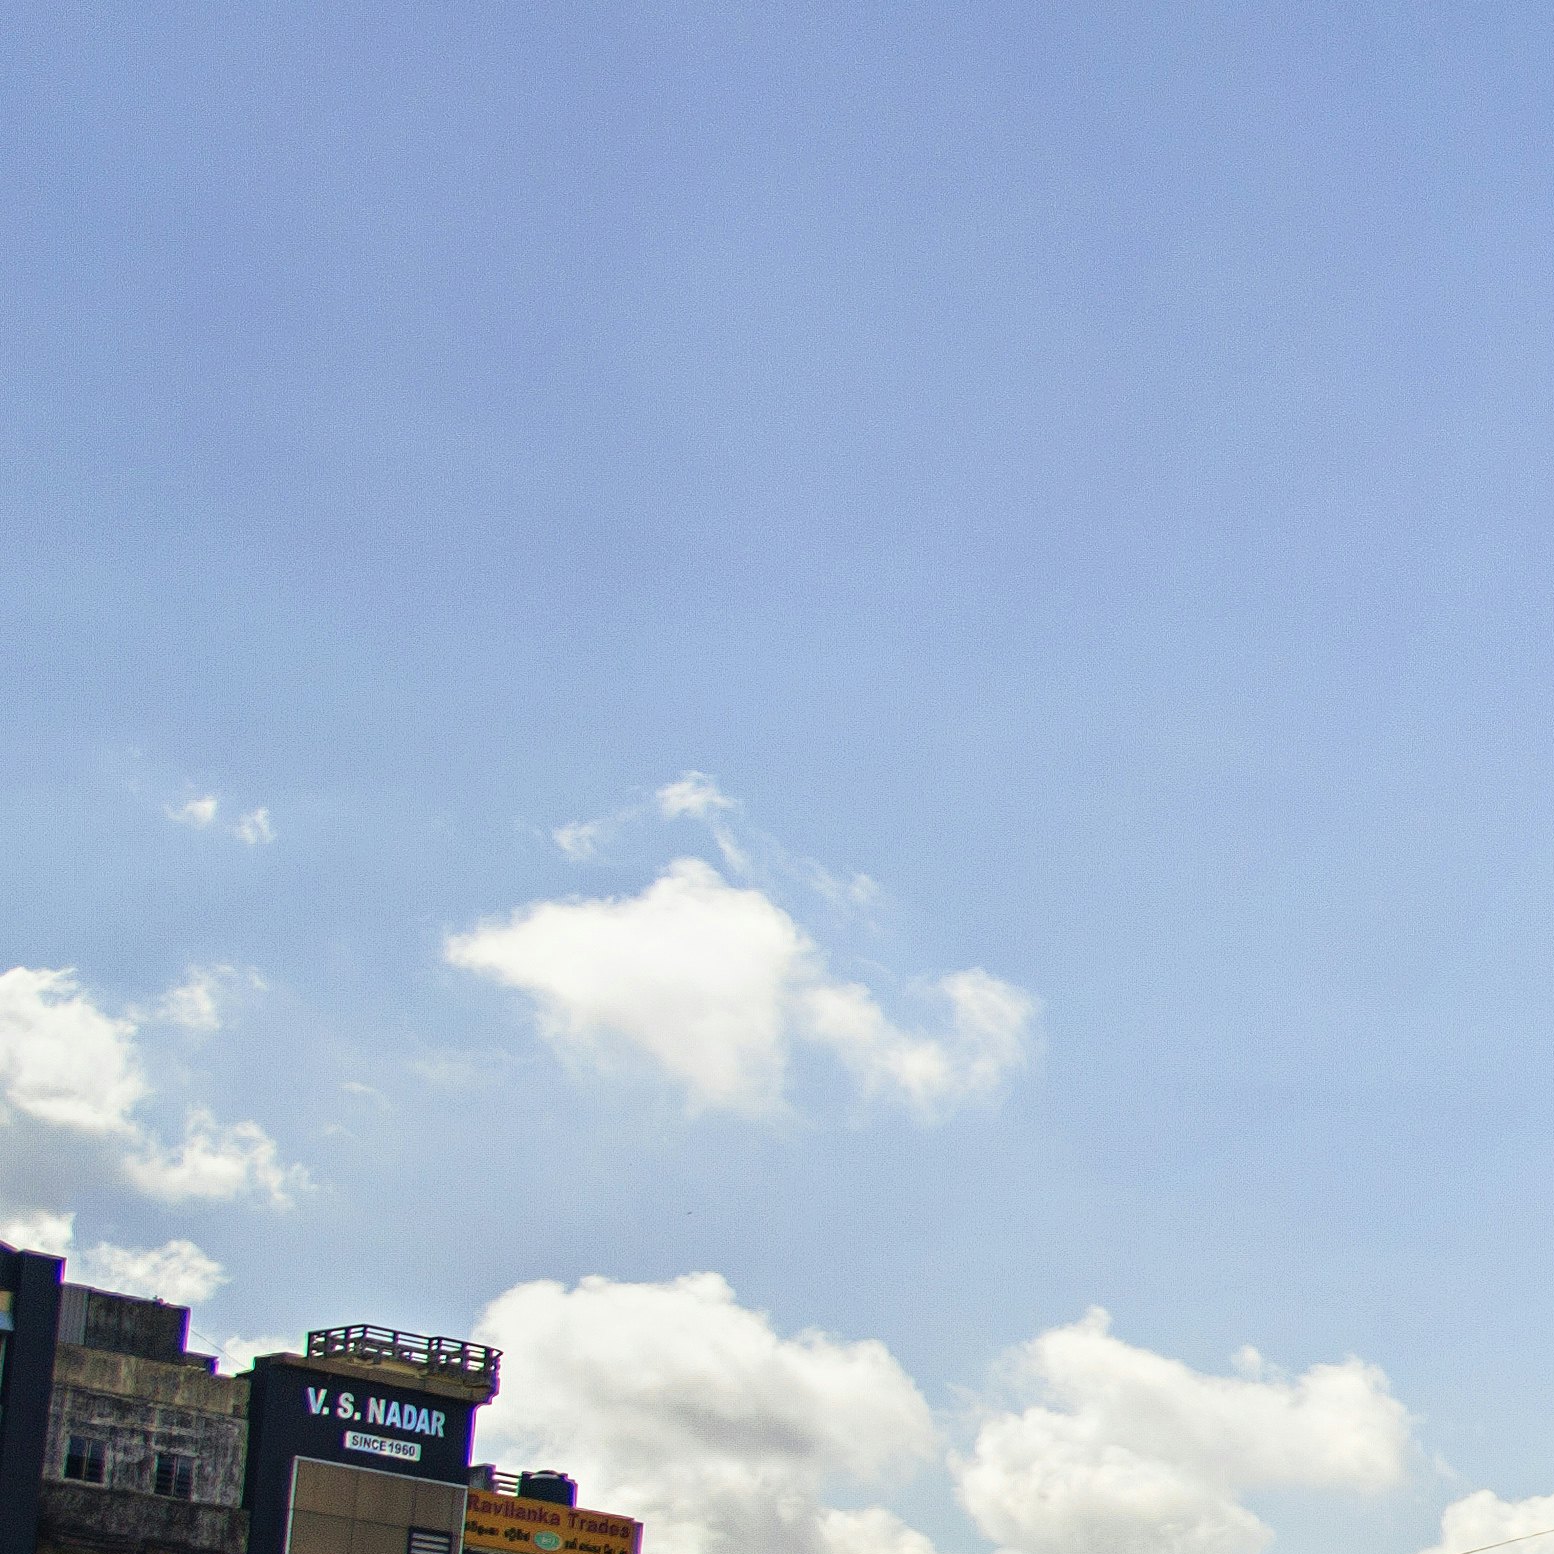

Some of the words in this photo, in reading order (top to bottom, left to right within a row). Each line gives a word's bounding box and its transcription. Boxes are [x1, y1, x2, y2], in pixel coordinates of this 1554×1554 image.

[306, 1387, 330, 1415] V.
[337, 1392, 362, 1421] S.
[366, 1396, 446, 1438] NADAR
